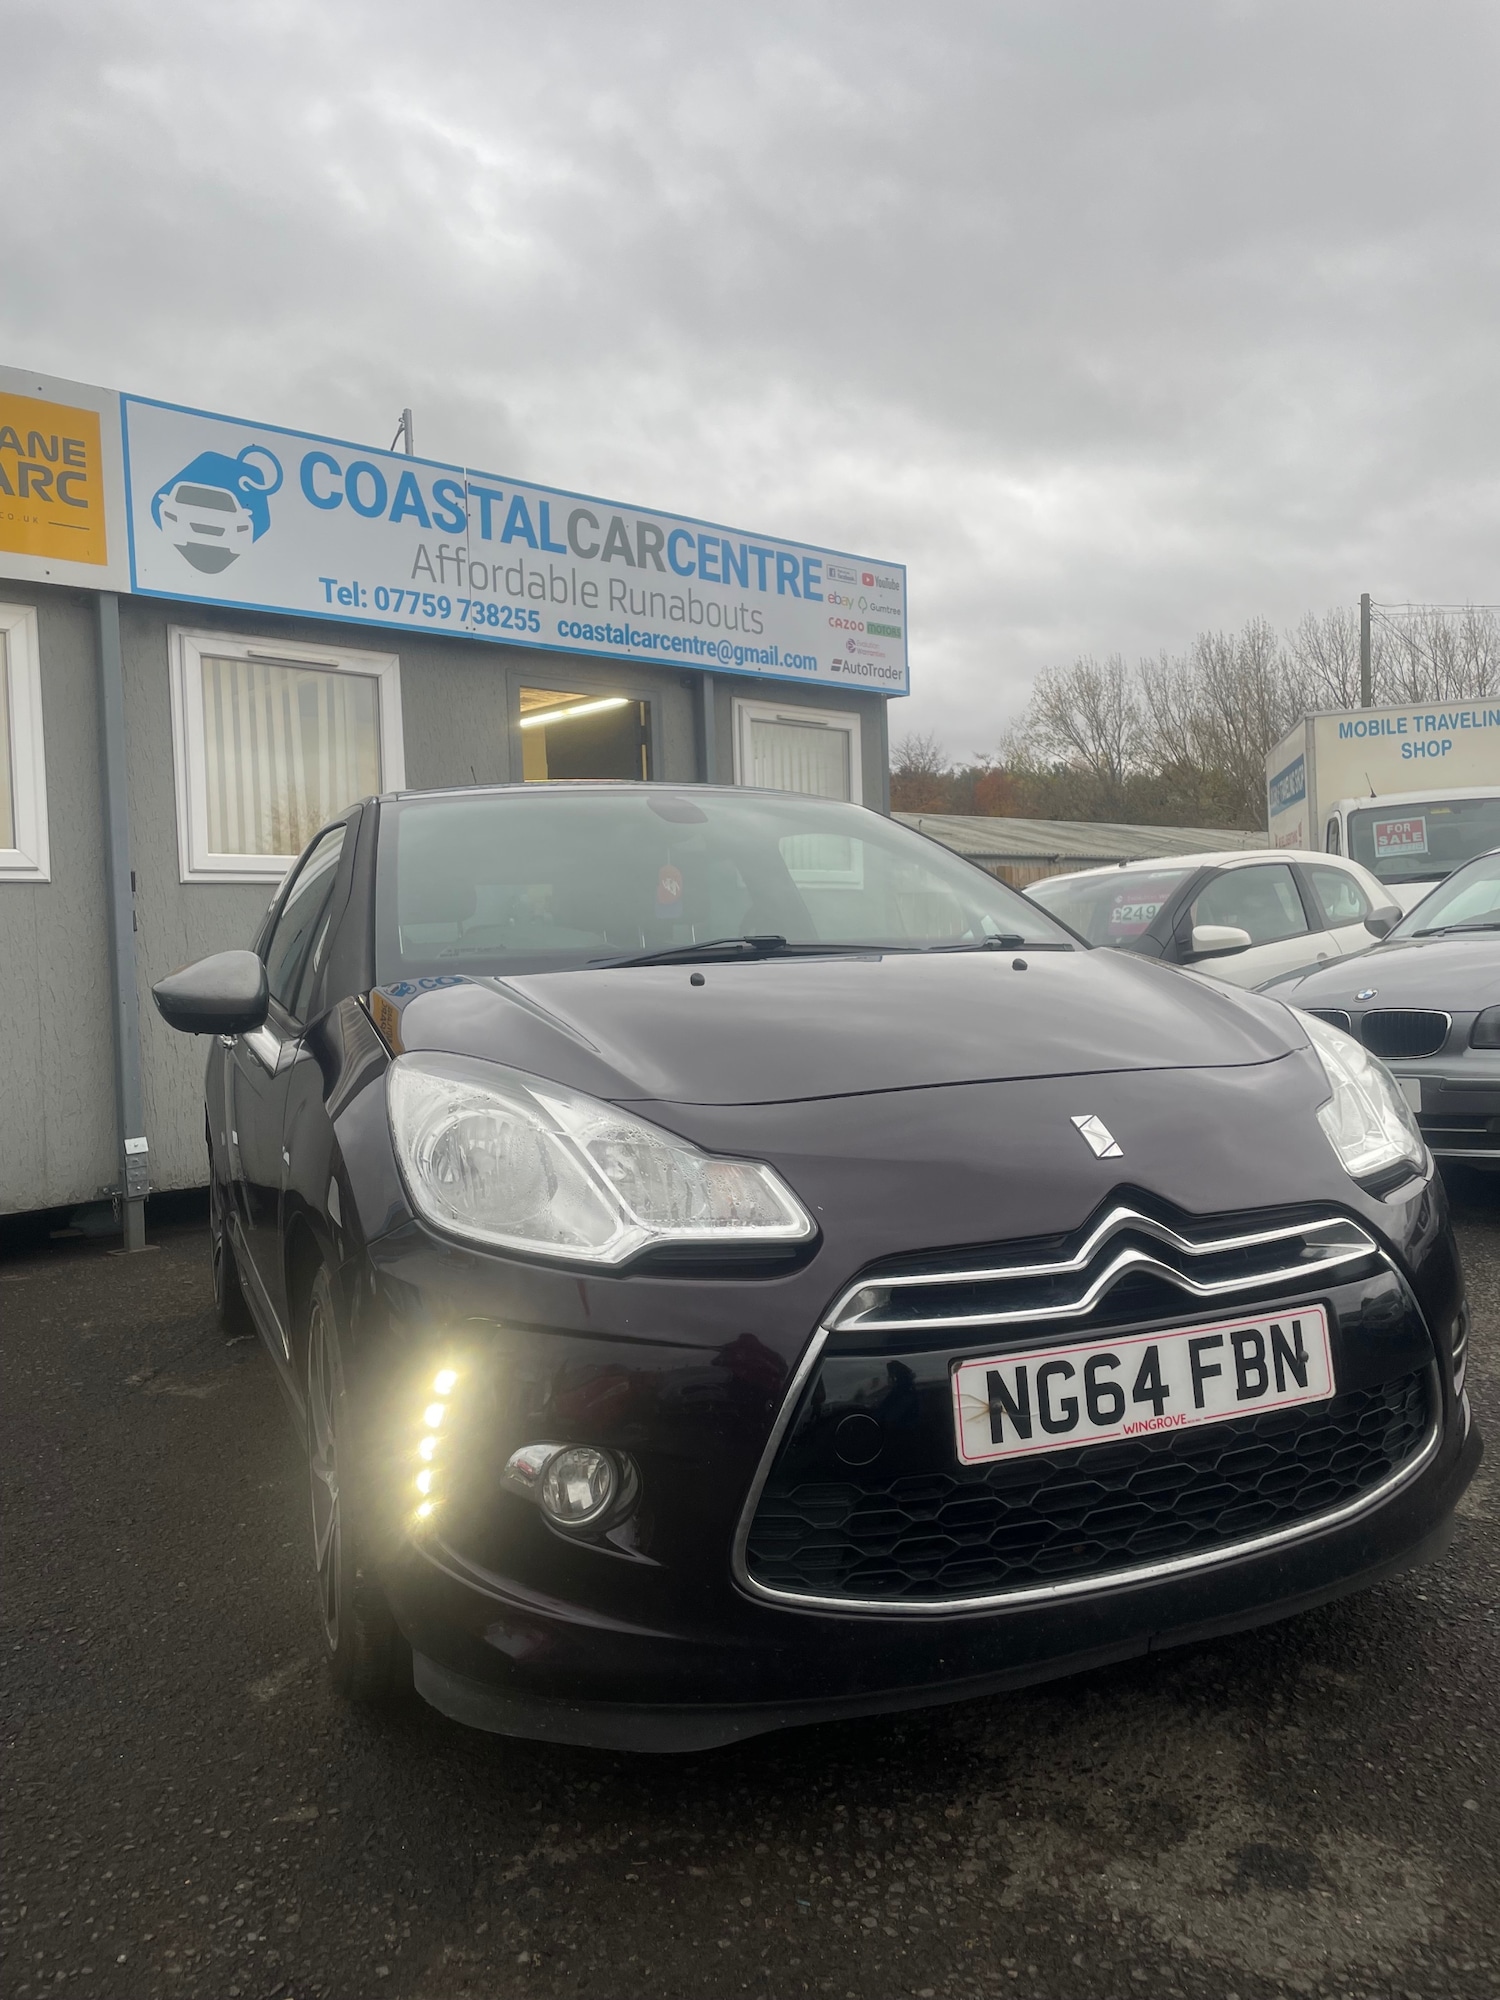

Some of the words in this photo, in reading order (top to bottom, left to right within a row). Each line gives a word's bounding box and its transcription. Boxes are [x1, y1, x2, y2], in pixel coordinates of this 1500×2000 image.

[299, 451, 824, 602] COASTALCARCENTRE
[411, 543, 599, 609] Affordable
[609, 578, 764, 635] Runabouts
[875, 575, 900, 591] YouTube
[828, 591, 854, 610] ebay
[870, 602, 902, 616] Gumtree
[318, 577, 367, 608] Tel:
[374, 586, 451, 619] 07759
[456, 598, 541, 633] 738255
[557, 619, 818, 672] coastalcarcentre@gmail.com
[828, 616, 865, 632] CAZOO
[842, 660, 903, 680] AutoTrader
[1339, 717, 1408, 739] MOBILE
[1413, 709, 1500, 733] TRAVELIN
[1401, 739, 1453, 760] SHOP
[1386, 823, 1411, 834] FOR
[1378, 832, 1423, 846] SALE
[985, 1345, 1170, 1445] NG64
[1188, 1320, 1309, 1409] FBN
[1123, 1413, 1187, 1435] WINGROVE
